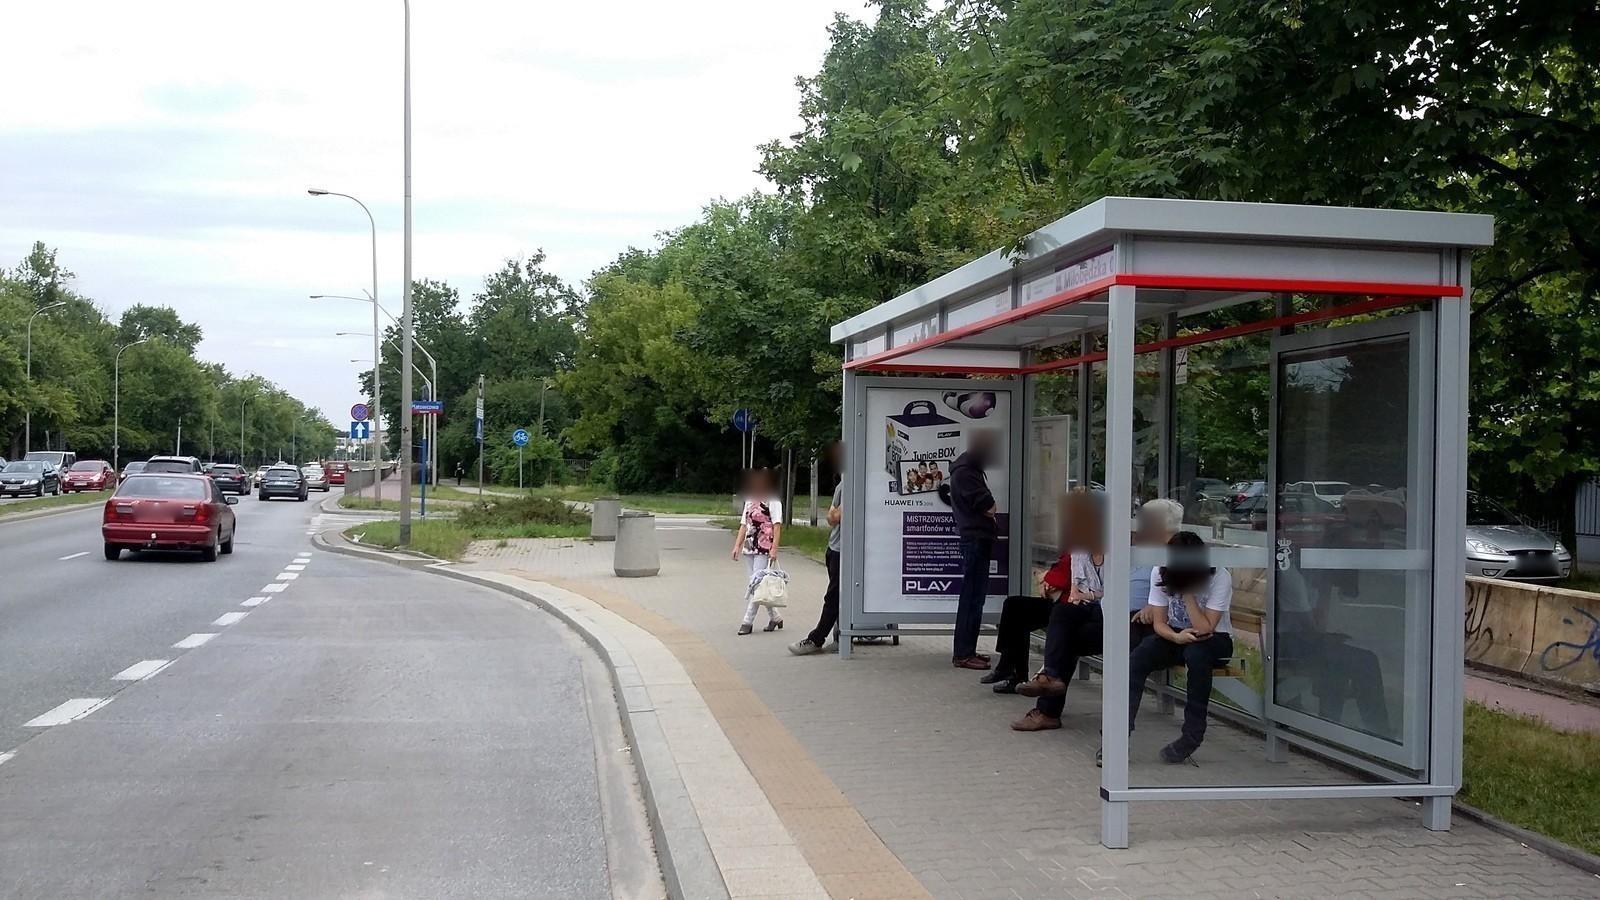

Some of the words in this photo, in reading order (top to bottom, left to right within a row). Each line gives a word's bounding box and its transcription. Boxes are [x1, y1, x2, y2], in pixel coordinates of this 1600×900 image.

[906, 515, 954, 523] MISTRZOWSKA
[906, 524, 943, 532] smartfonów
[905, 580, 952, 591] PLAY
